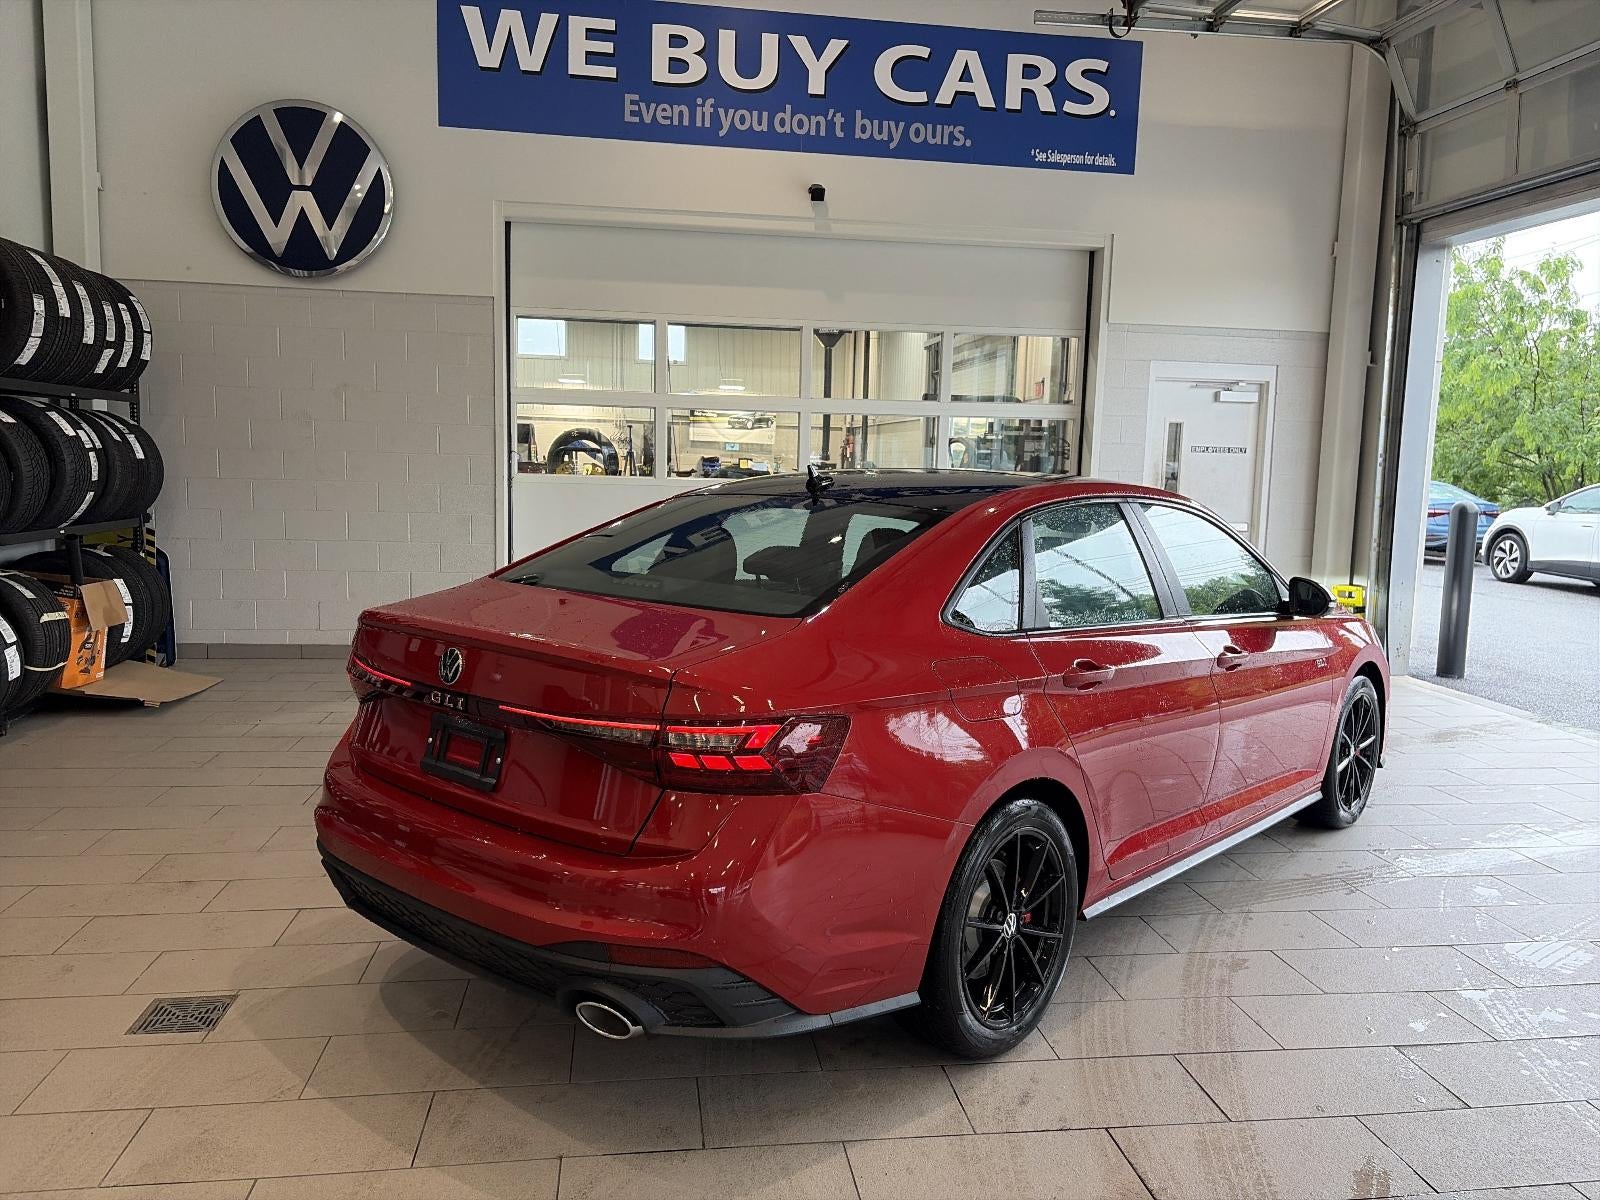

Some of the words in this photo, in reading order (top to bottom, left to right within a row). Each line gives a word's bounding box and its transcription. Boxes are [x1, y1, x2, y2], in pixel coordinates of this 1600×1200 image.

[460, 4, 618, 81] WE
[651, 23, 850, 98] BUY
[873, 44, 1117, 119] CARS.
[624, 93, 690, 127] Even
[695, 97, 715, 128] if
[717, 107, 769, 137] you
[854, 109, 905, 150] buy
[908, 121, 973, 148] ours.
[1047, 149, 1084, 166] Salesperson
[1084, 151, 1095, 165] for
[1094, 152, 1117, 167] details.
[1191, 446, 1229, 454] EMPLOYEES
[431, 690, 464, 710] GLI
